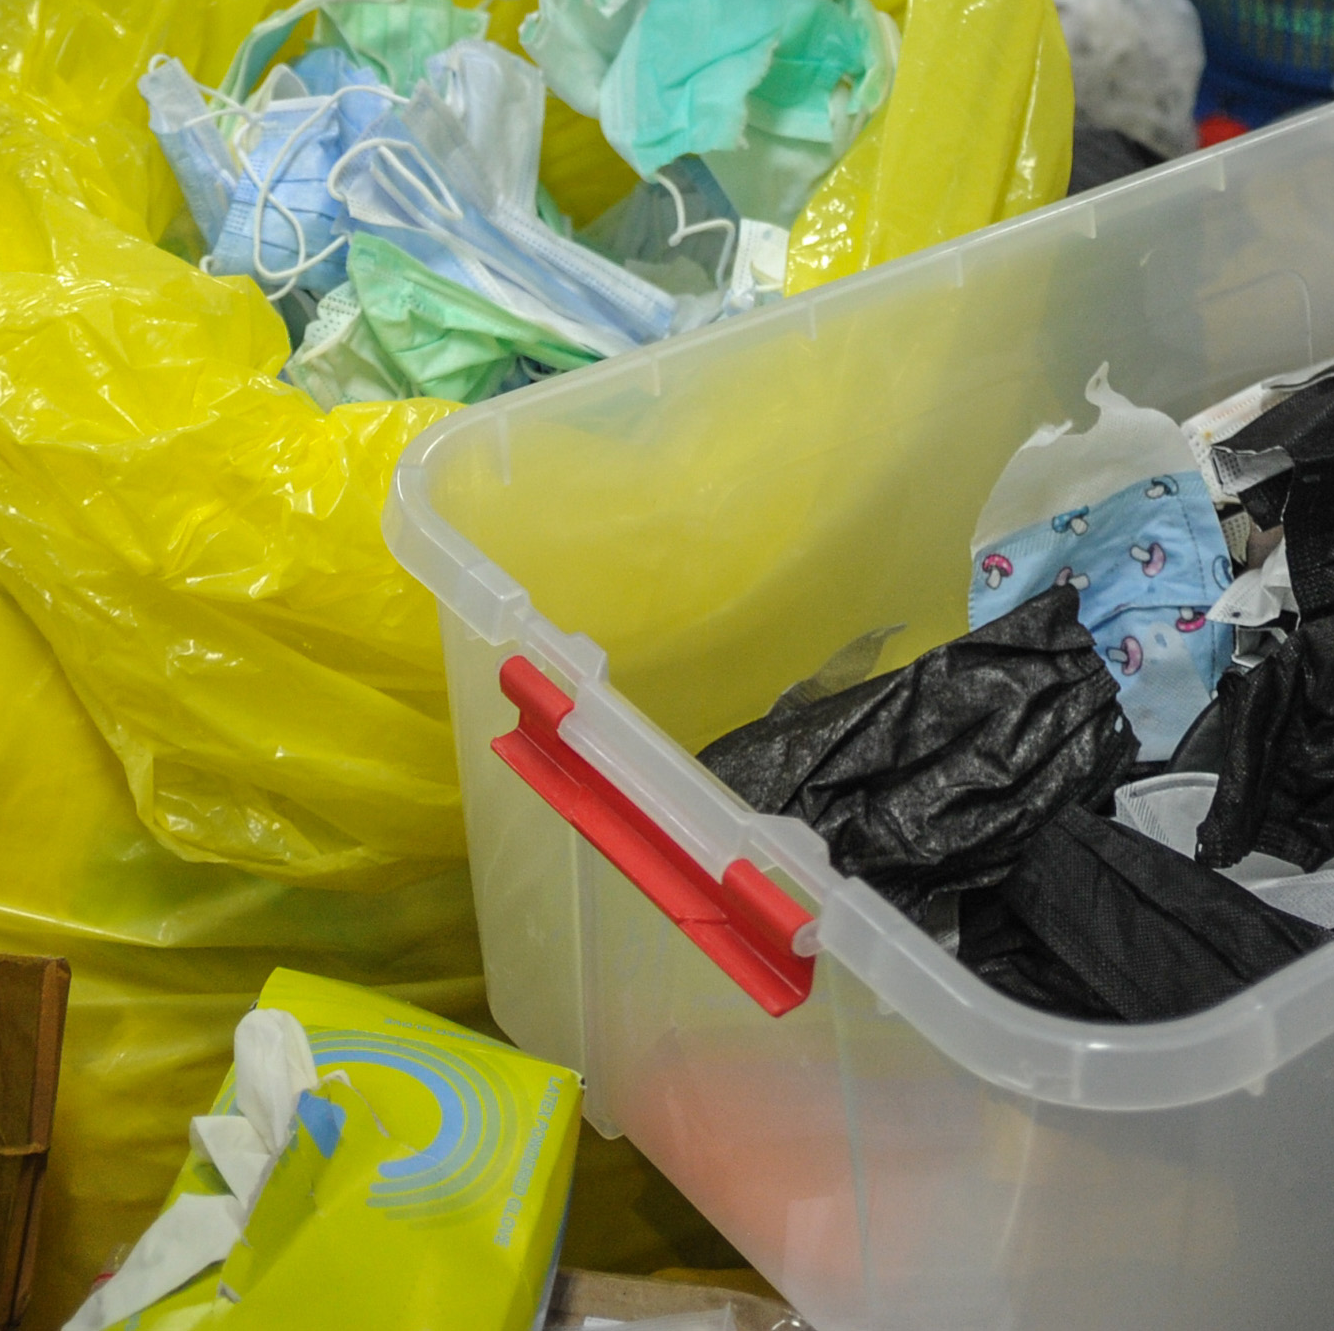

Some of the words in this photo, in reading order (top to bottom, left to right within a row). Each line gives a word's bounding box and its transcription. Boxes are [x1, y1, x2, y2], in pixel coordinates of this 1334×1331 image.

[537, 1075, 564, 1120] LATEX
[512, 1117, 550, 1197] POWDERED
[493, 1196, 523, 1248] GLOVE
